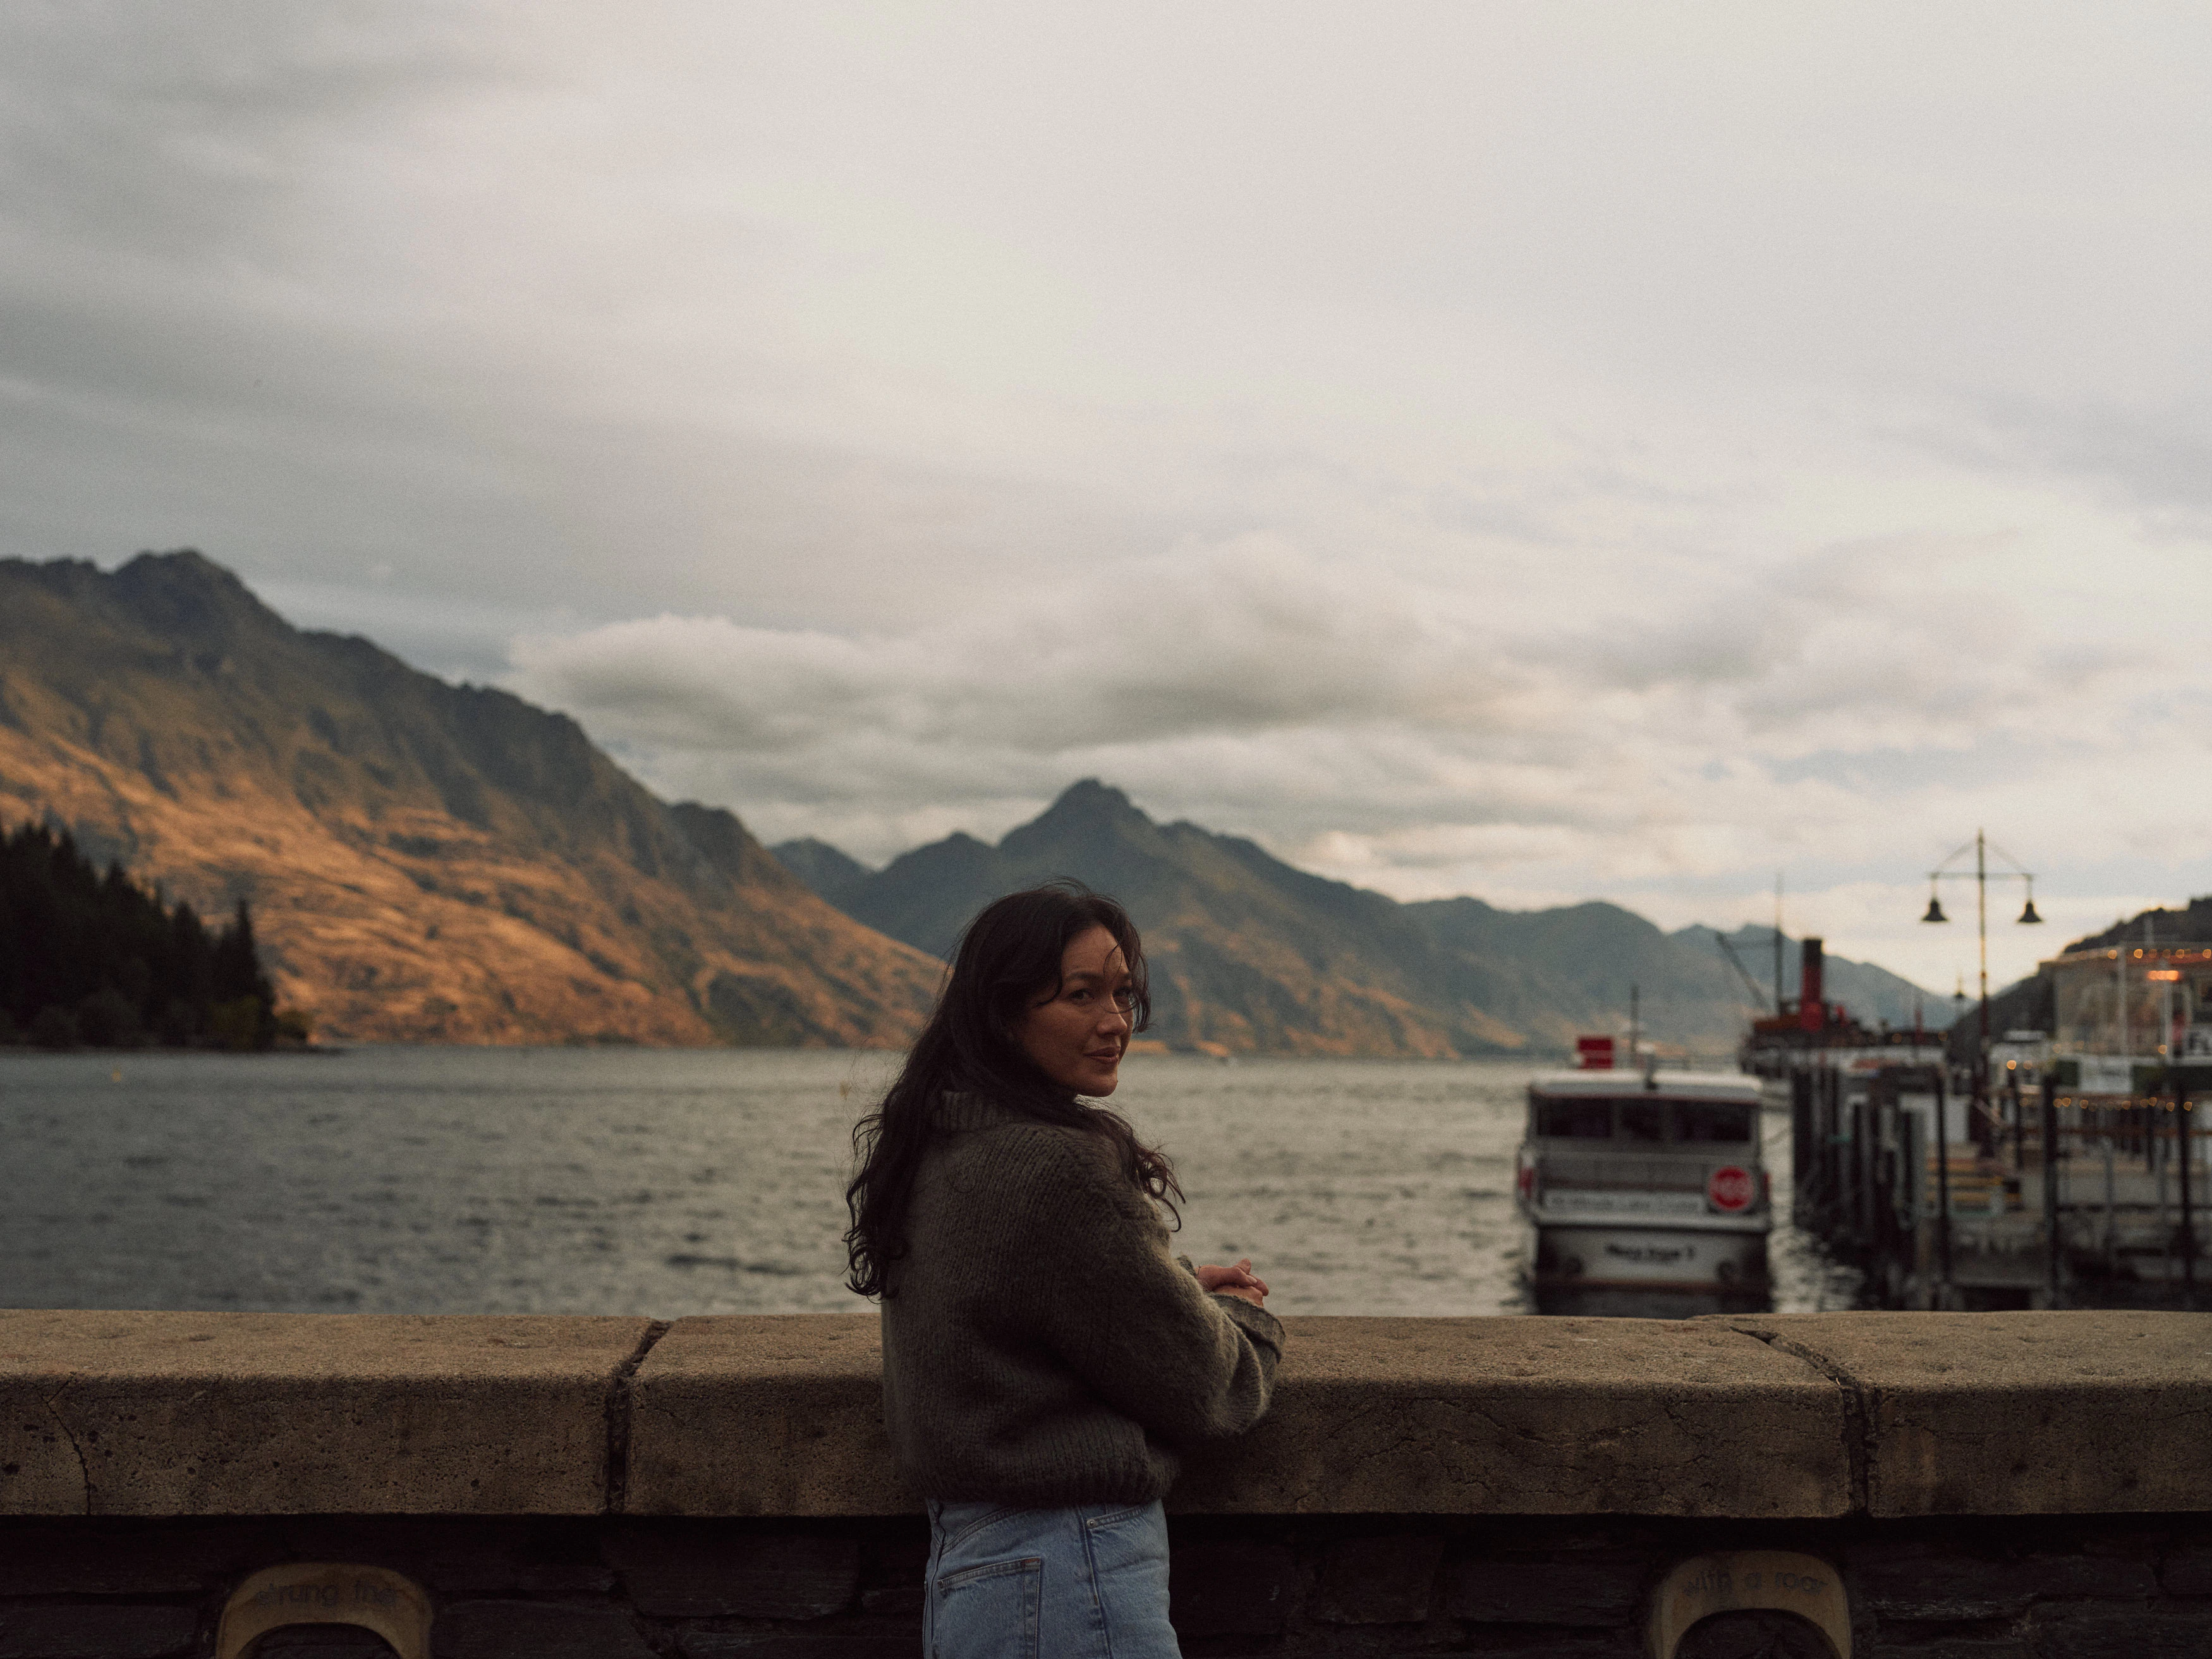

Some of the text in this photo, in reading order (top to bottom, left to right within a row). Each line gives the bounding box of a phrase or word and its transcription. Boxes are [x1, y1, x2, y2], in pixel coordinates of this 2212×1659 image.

[258, 1579, 397, 1607] strung the
[1684, 1569, 1828, 1597] with a roar
